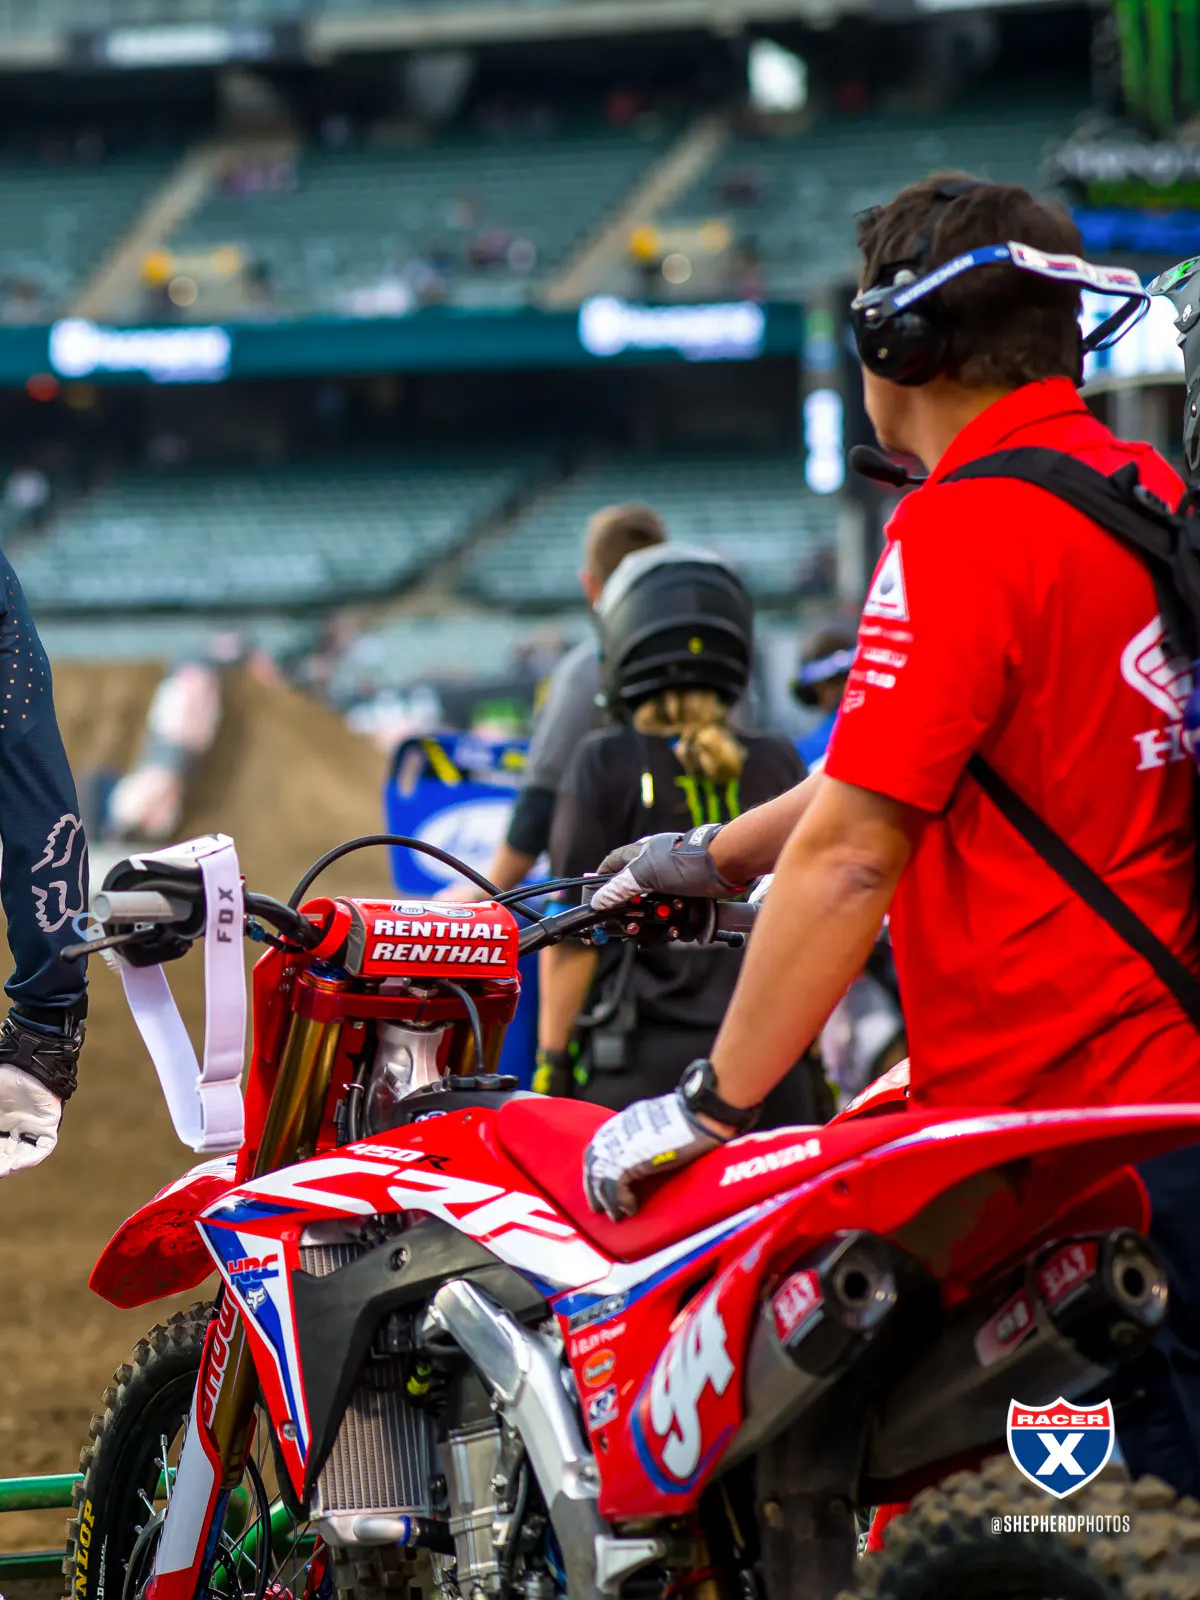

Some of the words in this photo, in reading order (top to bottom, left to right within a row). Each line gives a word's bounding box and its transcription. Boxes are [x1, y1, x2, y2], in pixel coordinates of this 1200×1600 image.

[216, 886, 235, 943] FOX
[373, 919, 510, 940] RENTHAL
[370, 942, 508, 965] RENTHAL
[719, 1138, 822, 1187] HONDA
[227, 1253, 280, 1286] HRC
[75, 1499, 96, 1600] NLOP
